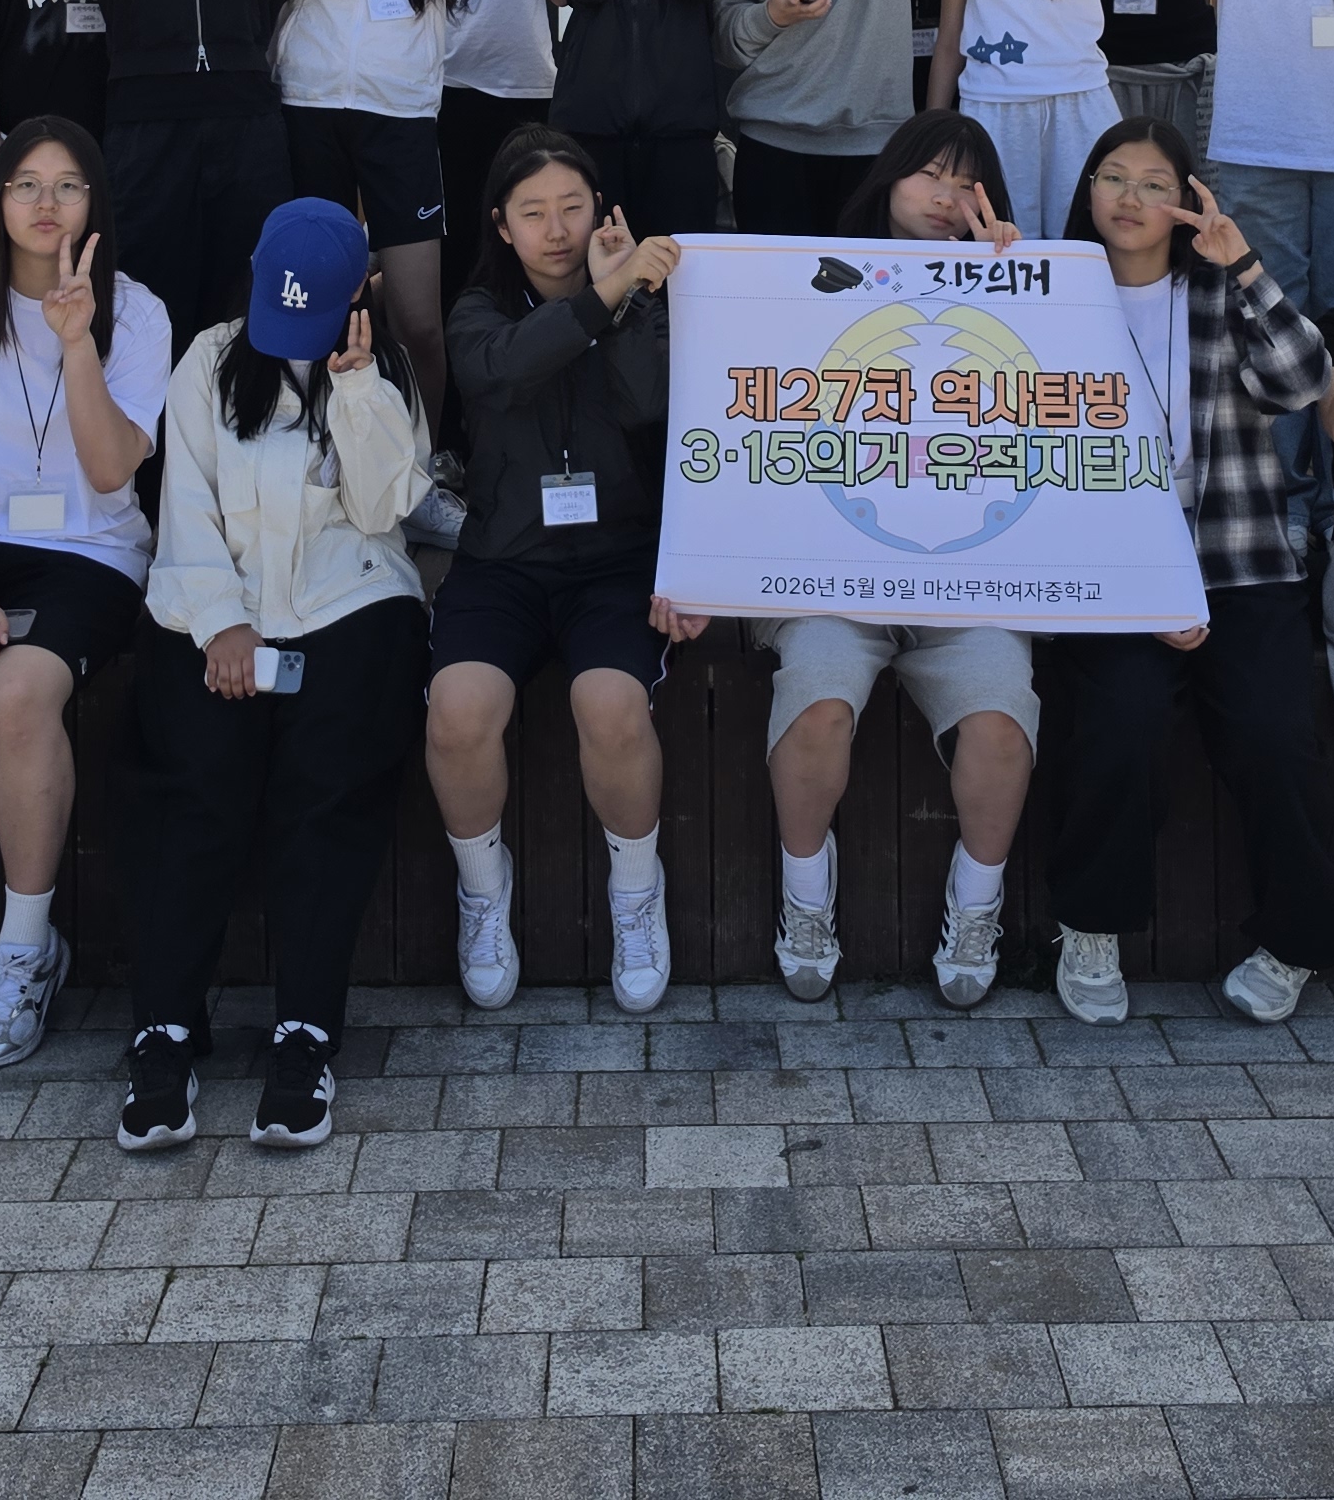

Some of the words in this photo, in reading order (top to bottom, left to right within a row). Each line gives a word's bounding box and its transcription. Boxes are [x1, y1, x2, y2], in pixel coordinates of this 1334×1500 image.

[281, 270, 309, 309] LA
[920, 259, 1051, 295] 3.15의거
[726, 366, 916, 426] 제27차
[930, 369, 1130, 429] 역사탐방
[680, 428, 909, 488] 3·15의거
[925, 432, 1170, 492] 유적지답사
[760, 576, 836, 598] 2026년
[842, 577, 876, 598] 5월
[883, 579, 916, 600] 9일
[923, 580, 1103, 602] 마산무학여자중학교
